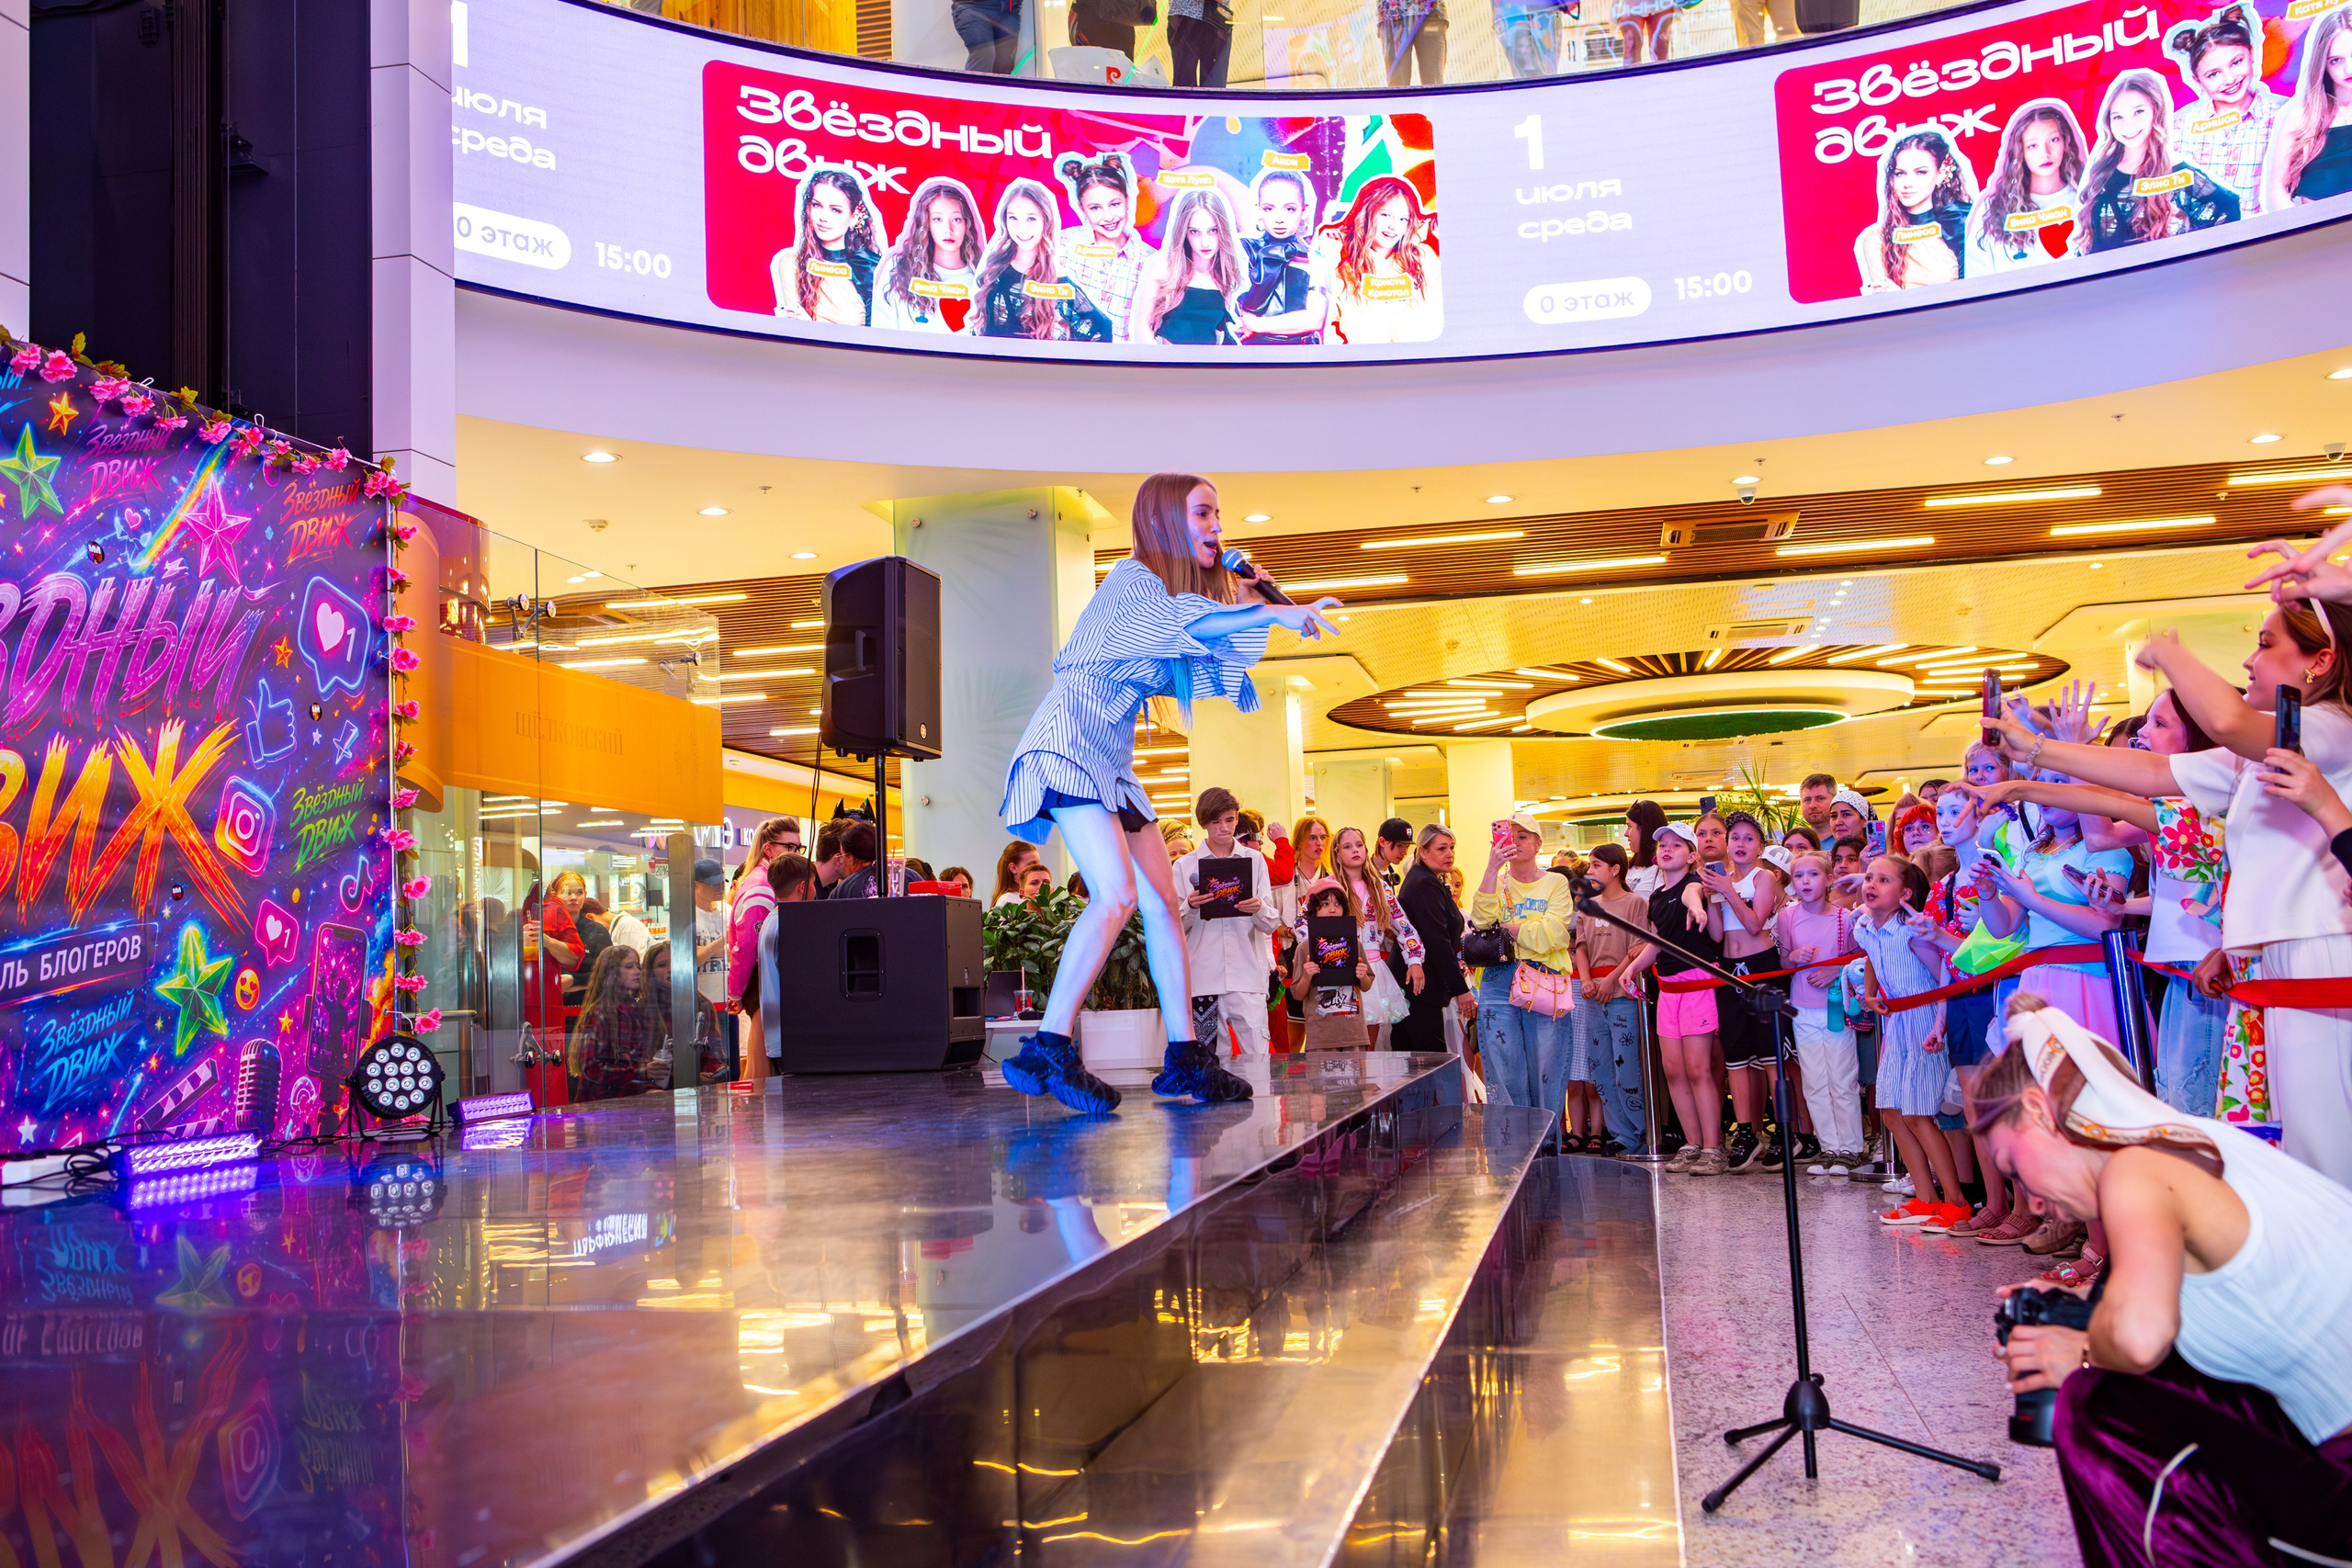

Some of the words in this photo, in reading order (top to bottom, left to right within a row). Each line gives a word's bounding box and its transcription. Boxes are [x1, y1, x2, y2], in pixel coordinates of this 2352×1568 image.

[1811, 5, 2160, 115] Звёздный
[736, 85, 1052, 159] Звёздный
[1514, 114, 1544, 170] 1
[1815, 103, 2001, 164] двж
[2193, 115, 2238, 132] Аришок
[738, 135, 910, 194] двж
[1515, 178, 1622, 205] июля
[456, 216, 472, 238] 0
[481, 225, 554, 257] этаж
[1517, 209, 1633, 243] среда
[595, 242, 672, 278] 15:00
[1540, 295, 1555, 313] 0
[1564, 290, 1634, 312] этаж
[1674, 270, 1752, 300] 15:00
[40, 935, 141, 982] БЛОГЕРОВ
